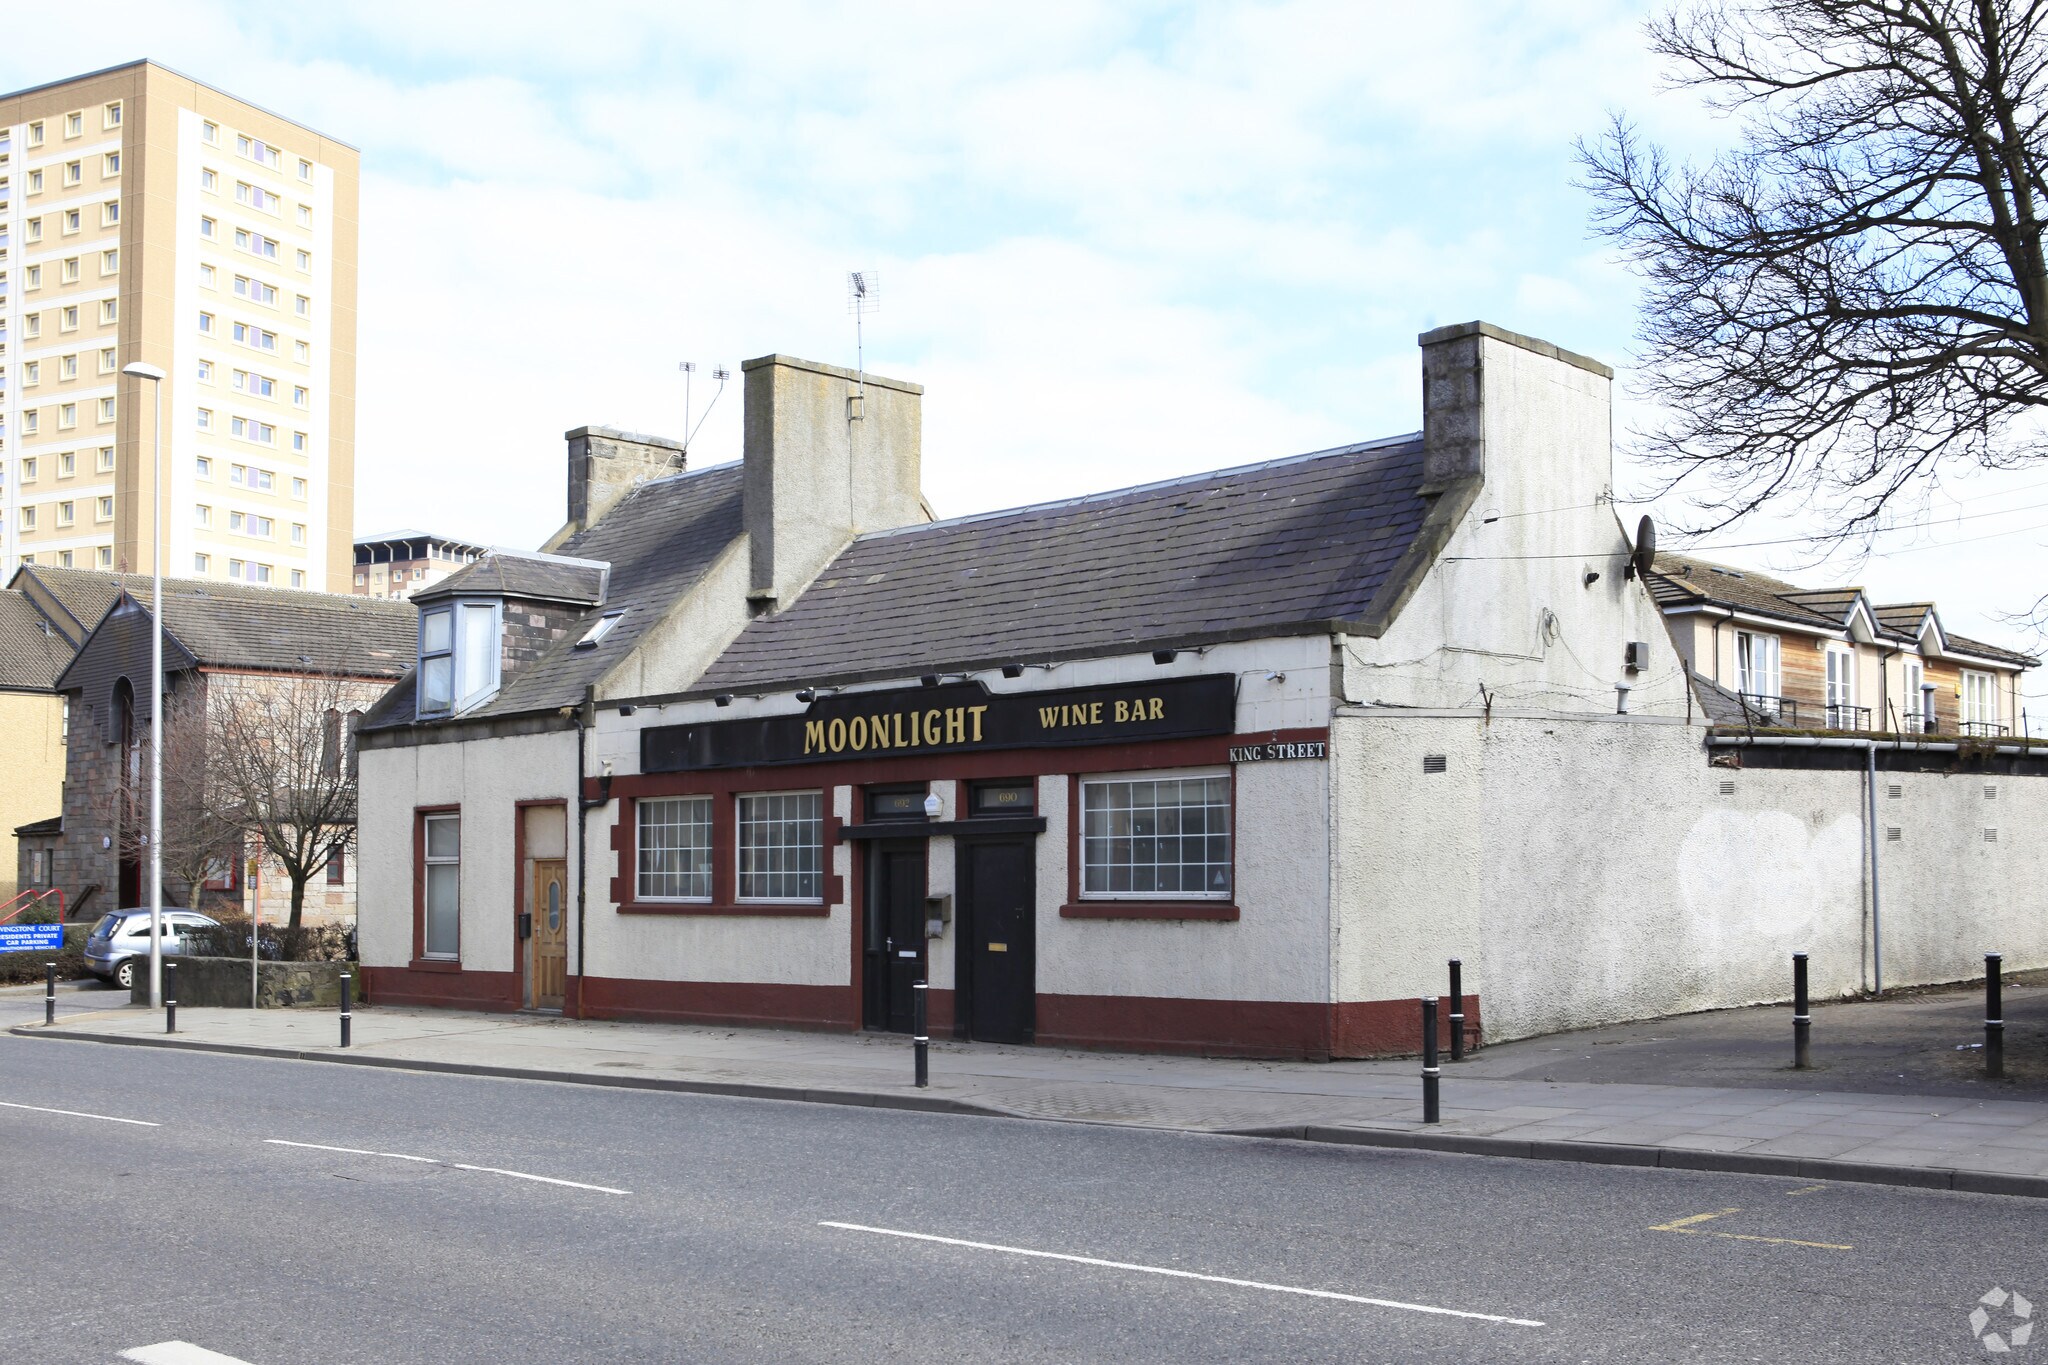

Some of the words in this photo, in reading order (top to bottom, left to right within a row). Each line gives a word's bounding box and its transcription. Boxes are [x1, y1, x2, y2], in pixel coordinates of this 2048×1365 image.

[804, 705, 988, 754] MOONLIGHT
[1038, 702, 1103, 728] WINE
[1114, 697, 1165, 722] BAR
[1229, 747, 1261, 762] KING
[1267, 742, 1325, 759] STREET
[894, 798, 910, 808] 692
[999, 792, 1017, 803] 690
